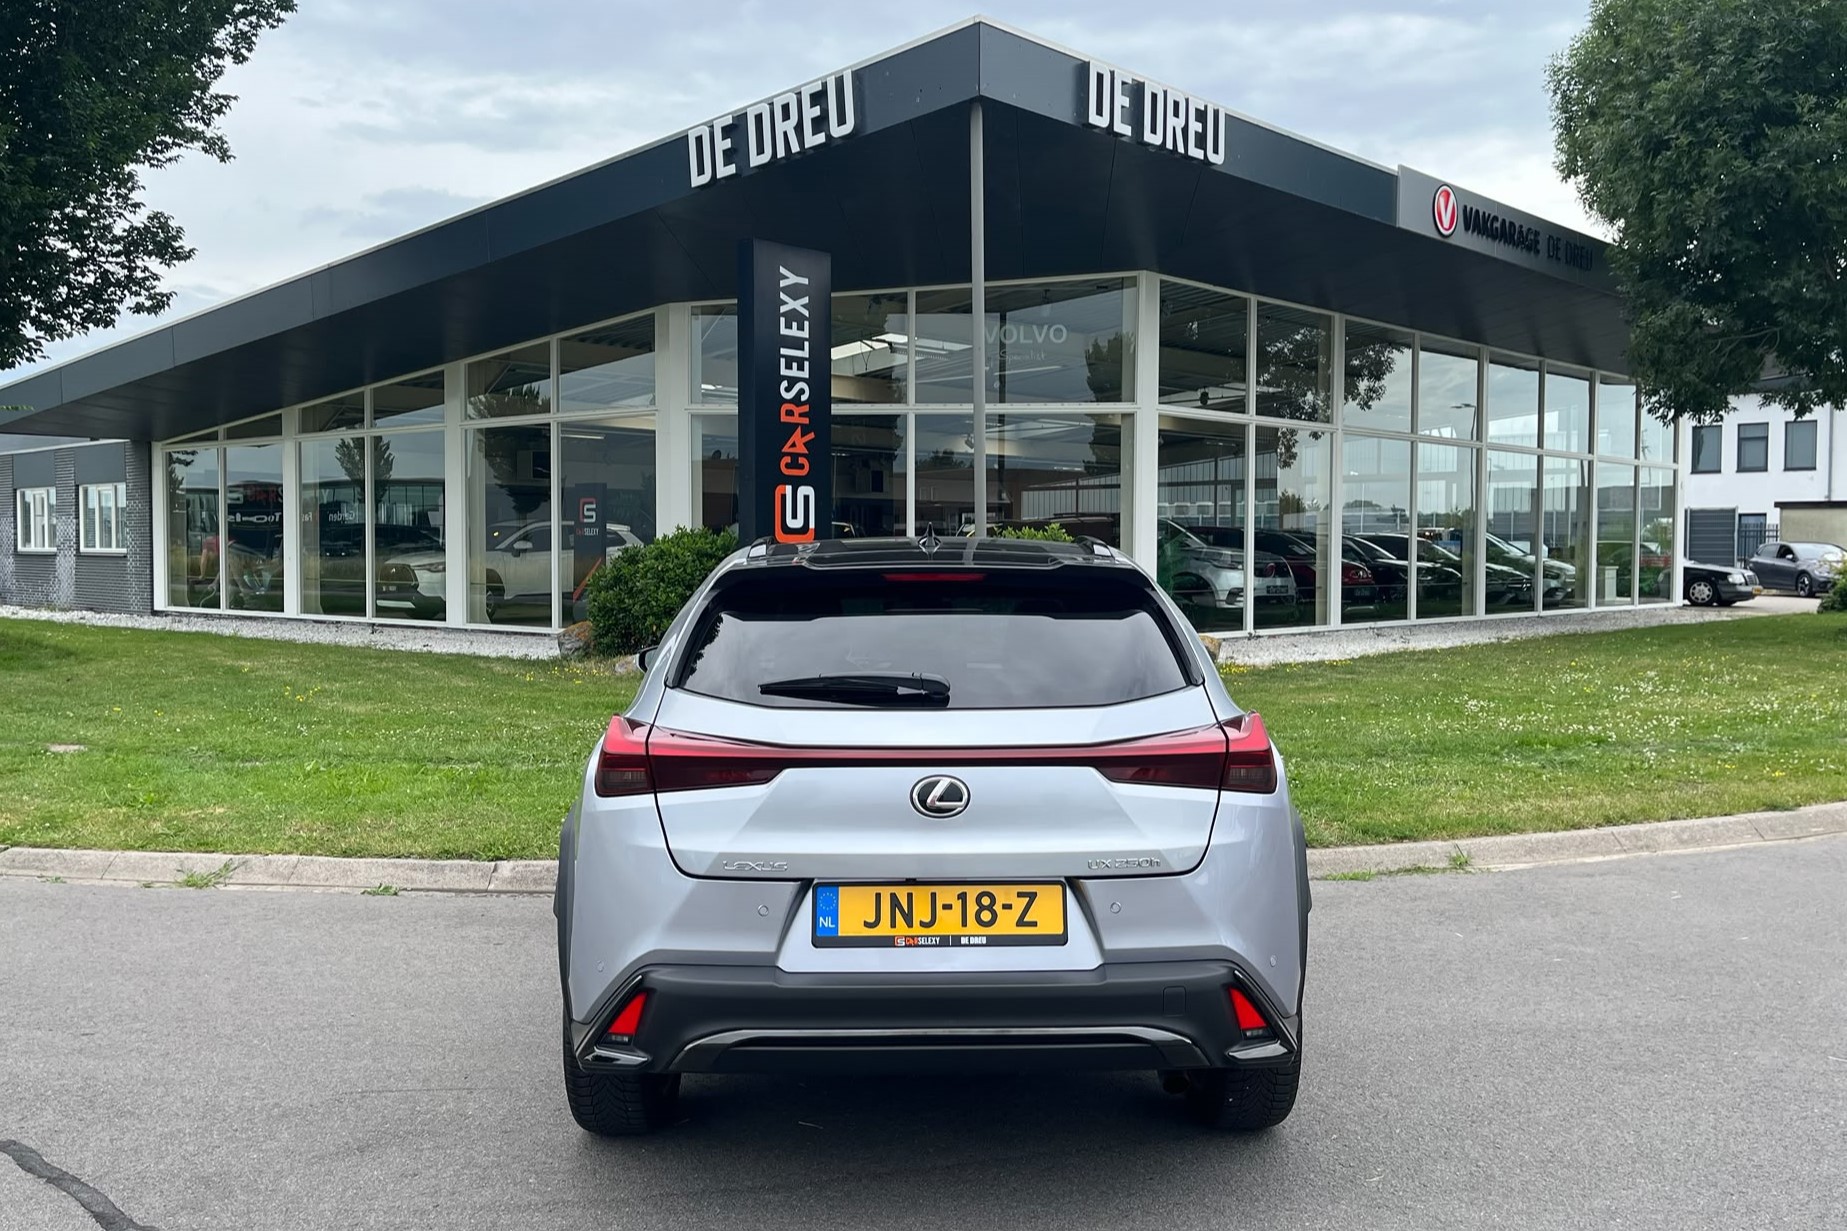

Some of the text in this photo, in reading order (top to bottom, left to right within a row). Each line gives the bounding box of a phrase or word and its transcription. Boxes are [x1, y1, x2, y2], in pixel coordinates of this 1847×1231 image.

[1088, 60, 1226, 165] DE DREU
[688, 69, 855, 188] DE DREU
[1463, 205, 1593, 271] VAKGARAGE DE DREU
[984, 324, 1068, 344] VOLVO
[779, 265, 816, 476] CARSELEXY
[722, 860, 788, 872] LEXUS
[1088, 856, 1161, 870] UX 250h
[819, 916, 835, 929] NL
[863, 890, 1038, 929] JNJ-18-Z
[960, 936, 970, 945] DE
[970, 936, 987, 945] DREU
